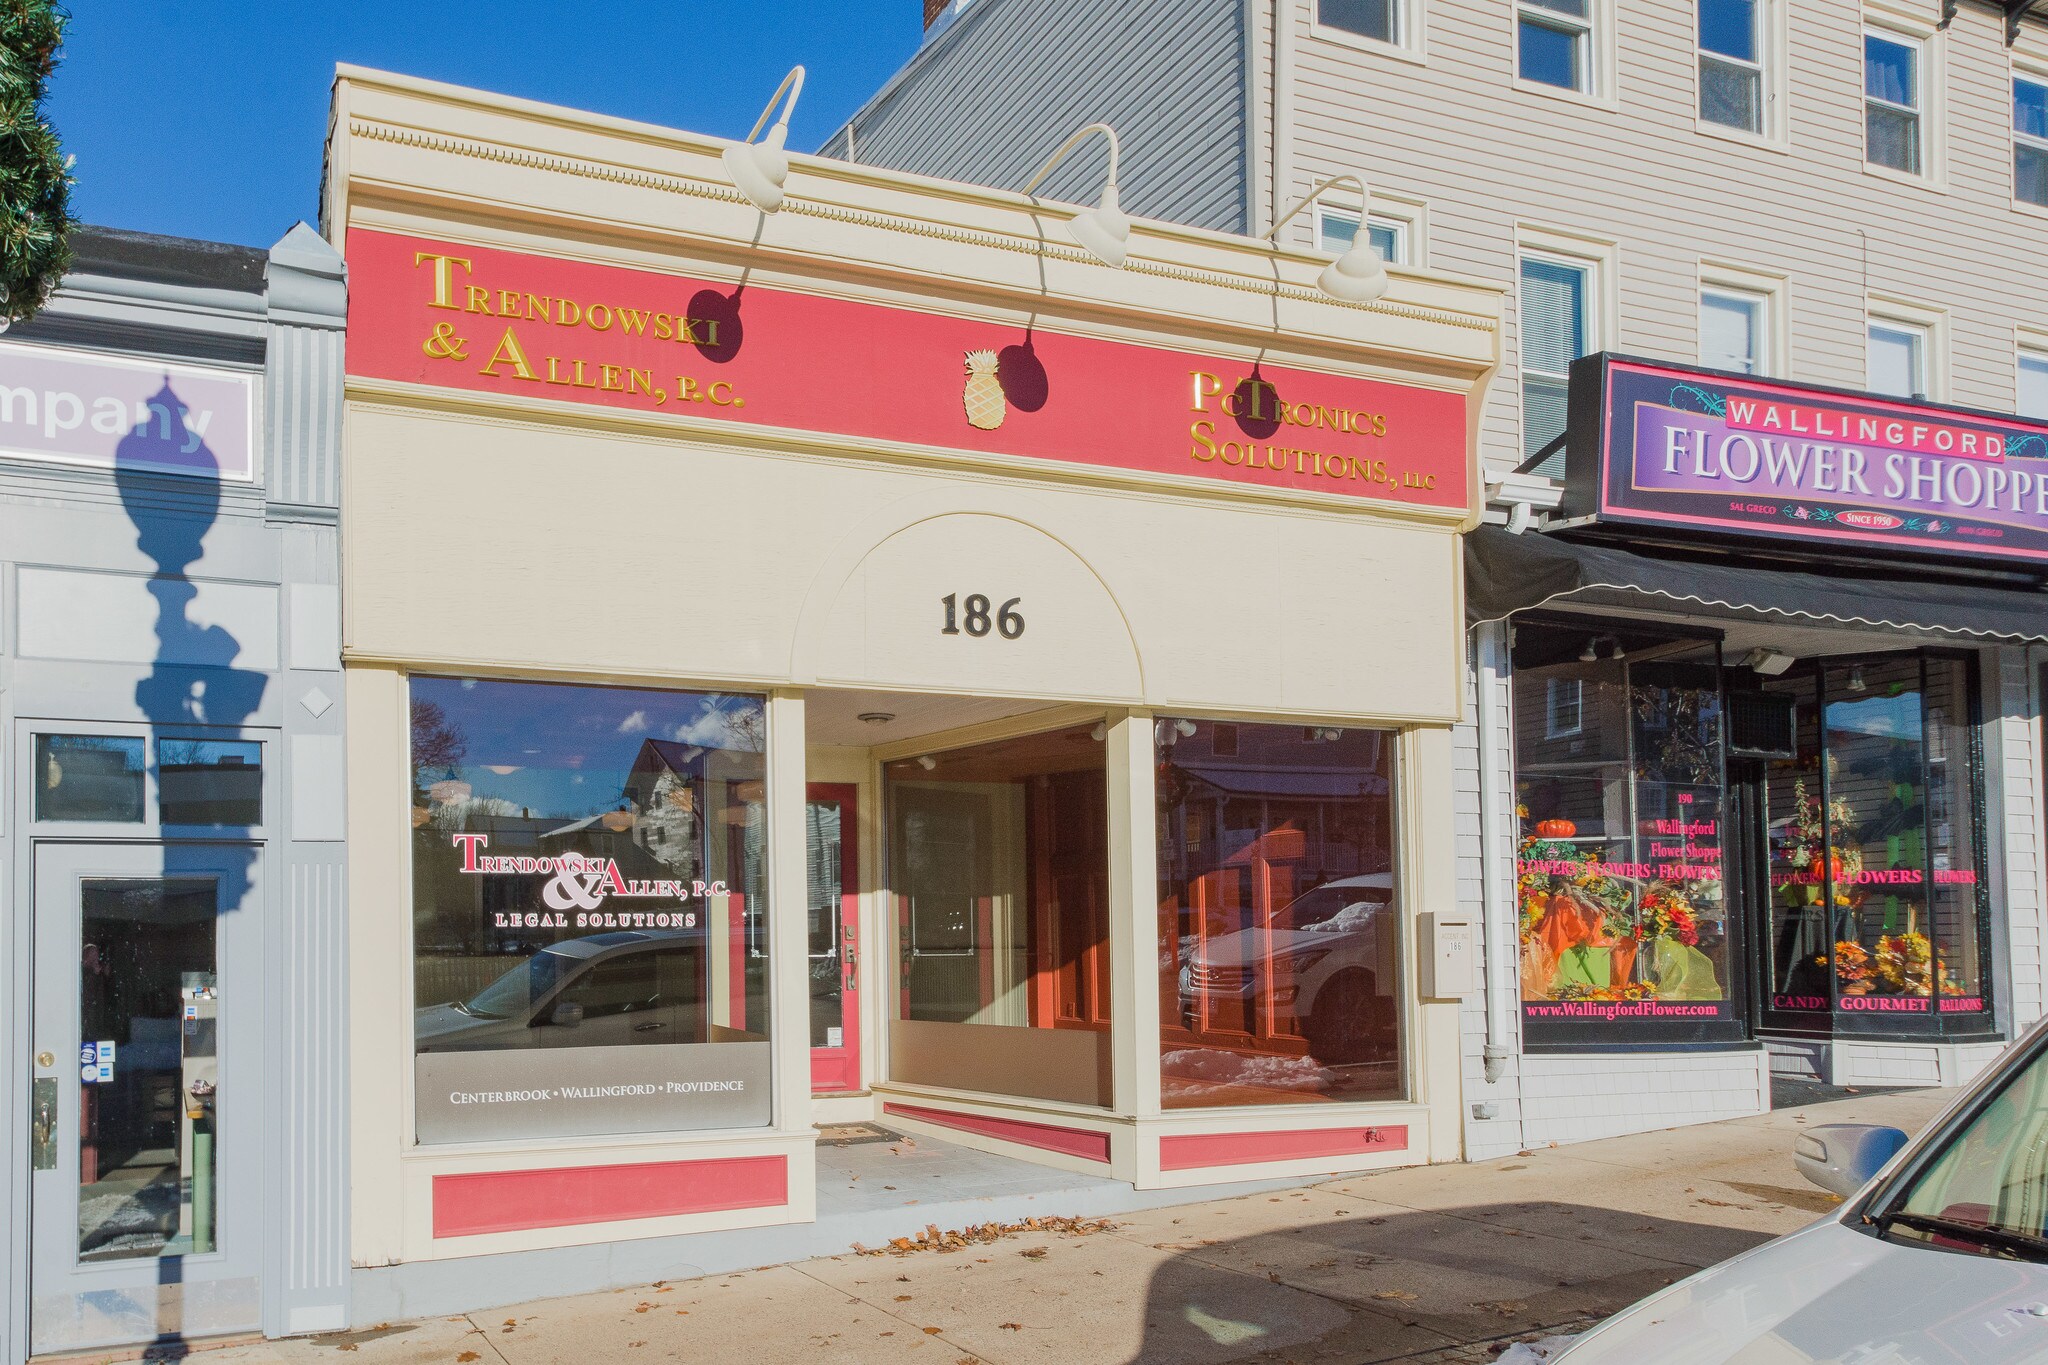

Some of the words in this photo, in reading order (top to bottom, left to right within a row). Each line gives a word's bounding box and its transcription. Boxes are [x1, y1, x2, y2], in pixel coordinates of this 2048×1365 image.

[414, 251, 721, 347] TRENDOWSKI
[422, 321, 469, 361] &
[479, 326, 667, 405] ALLEN,
[676, 375, 745, 408] P.C.
[1729, 400, 2002, 457] WALLINGFORD
[1189, 420, 1398, 491] SOLUTIONS,
[1403, 471, 1436, 490] LLC
[1663, 425, 1871, 495] FLOWER
[1883, 454, 2048, 515] SHOPPE
[1746, 503, 1776, 515] GRECO
[1846, 513, 1871, 525] SINCE
[1873, 516, 1892, 527] 1950
[941, 592, 1025, 640] 186
[1678, 793, 1693, 804] 190
[1656, 819, 1715, 840] Wallingford
[1651, 842, 1684, 857] Flower
[1686, 842, 1722, 862] Shoppe
[453, 834, 605, 873] TRENDOWSKI
[543, 852, 603, 910] &
[594, 857, 688, 901] ALLEN,
[692, 880, 731, 897] P.C.
[1516, 859, 1577, 876] LOWERS
[1586, 861, 1650, 878] FLOWERS
[1658, 864, 1721, 880] FLOWERS
[1836, 869, 1923, 884] FLOWERS
[1933, 869, 1976, 884] FLOWERS
[495, 913, 568, 927] LEGAL
[577, 913, 696, 927] SOLUTIONS
[1450, 942, 1462, 951] 186
[1526, 1002, 1718, 1020] www.WallingfordFlower.com
[1773, 996, 1829, 1009] CANDY
[1840, 997, 1930, 1011] GOURMET
[1939, 998, 1984, 1012] BALLOONS
[450, 1089, 551, 1105] CENTERBROOK
[560, 1084, 656, 1099] WALLINGFORD
[666, 1080, 744, 1094] PROVIDENCE
